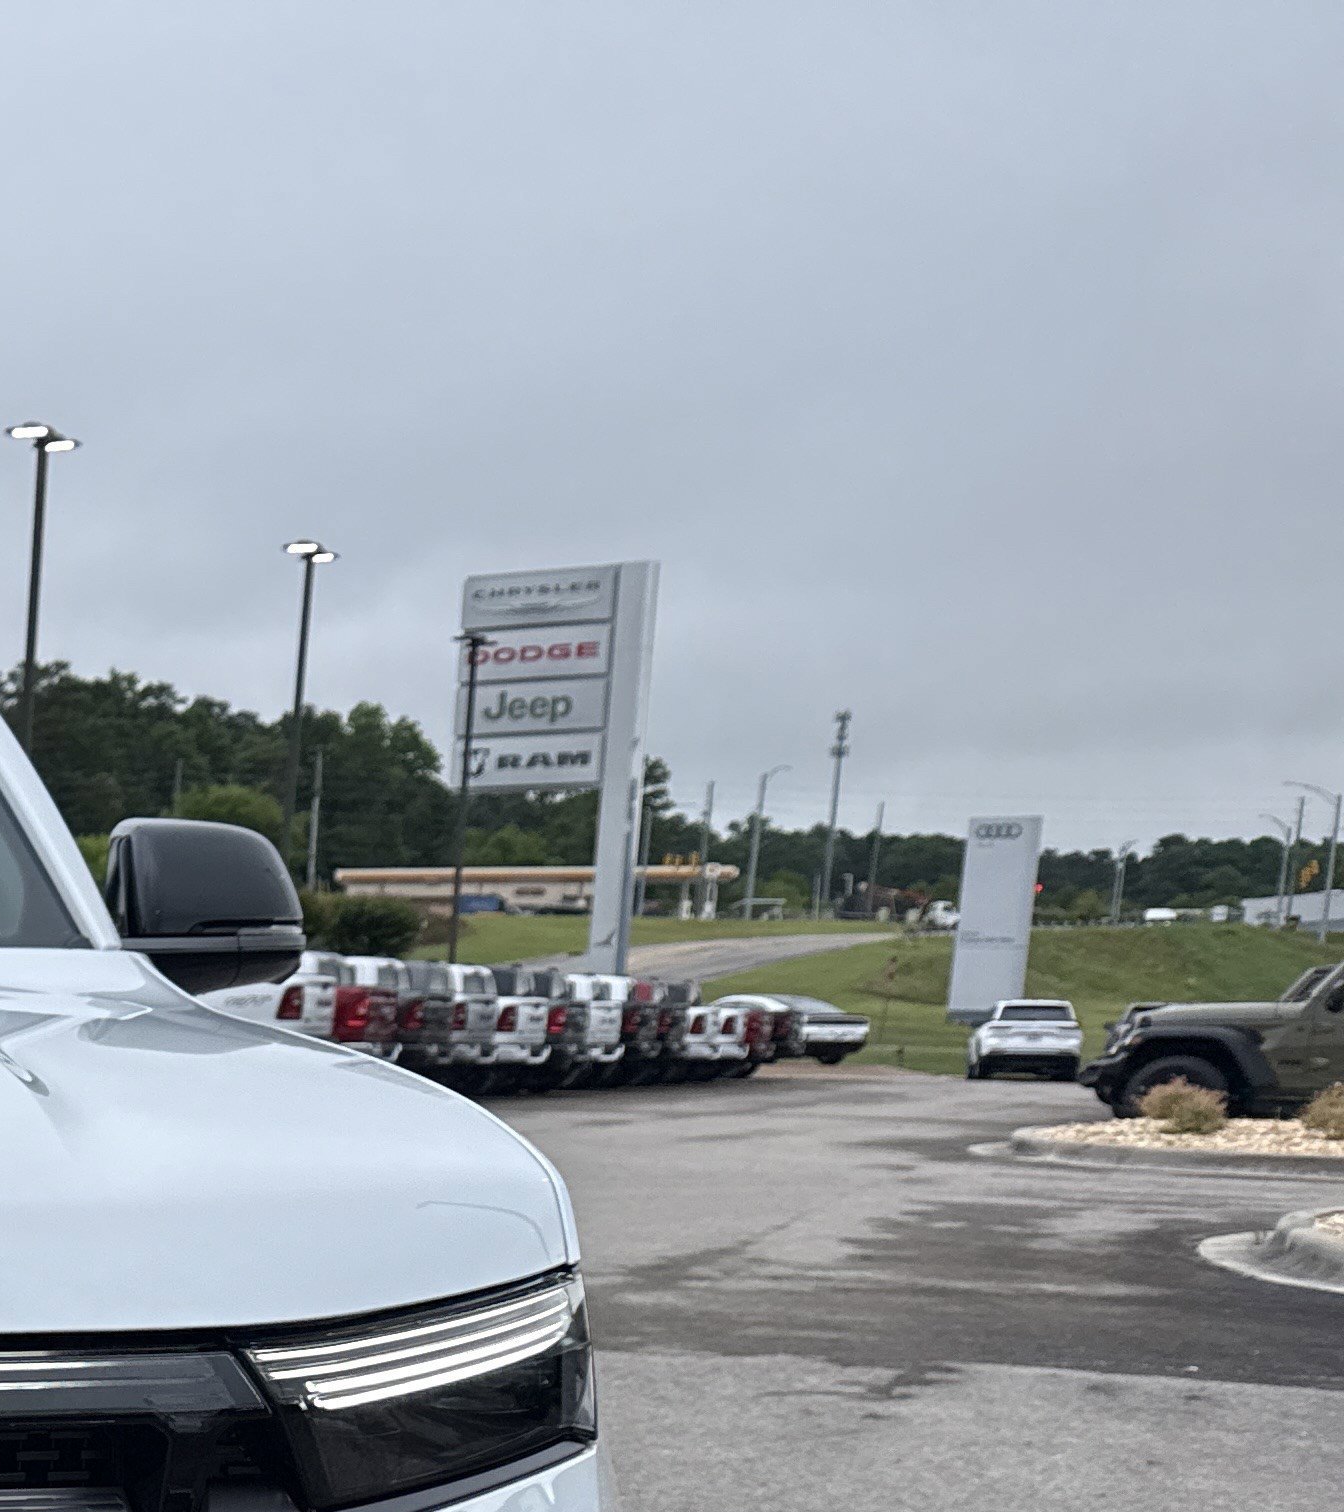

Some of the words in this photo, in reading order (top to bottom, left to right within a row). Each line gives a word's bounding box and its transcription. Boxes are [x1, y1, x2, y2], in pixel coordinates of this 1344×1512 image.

[472, 580, 601, 599] CHRYSLER
[467, 640, 599, 665] DODGE
[483, 689, 574, 723] Jeep
[497, 750, 591, 769] RAM
